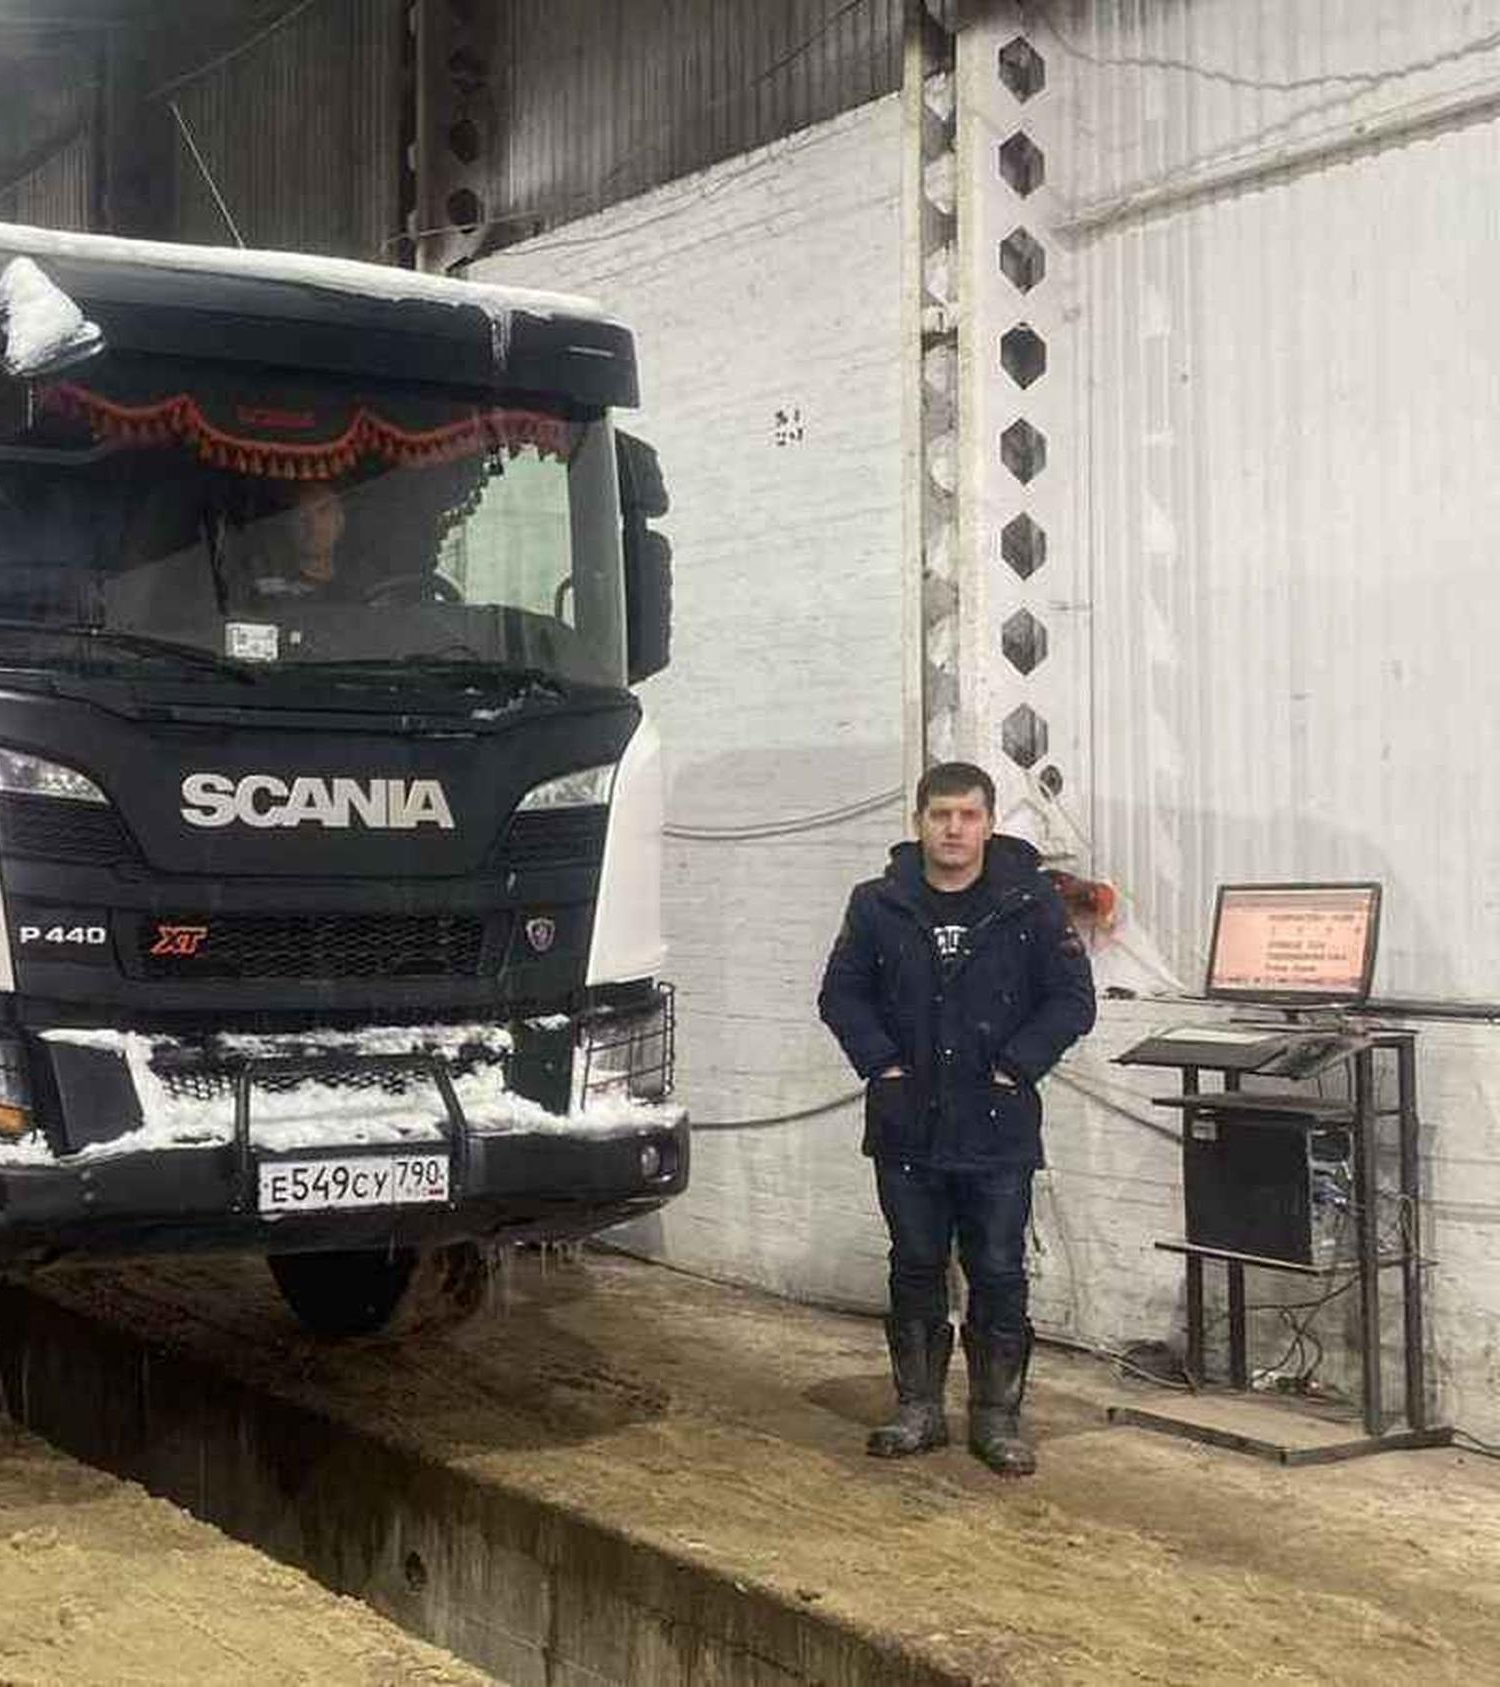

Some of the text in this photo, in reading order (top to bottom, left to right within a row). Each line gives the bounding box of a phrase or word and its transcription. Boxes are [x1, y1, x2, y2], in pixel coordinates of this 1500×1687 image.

[180, 773, 455, 829] SCANIA
[19, 926, 107, 944] P 440
[150, 924, 208, 955] XT
[396, 1160, 439, 1187] 790
